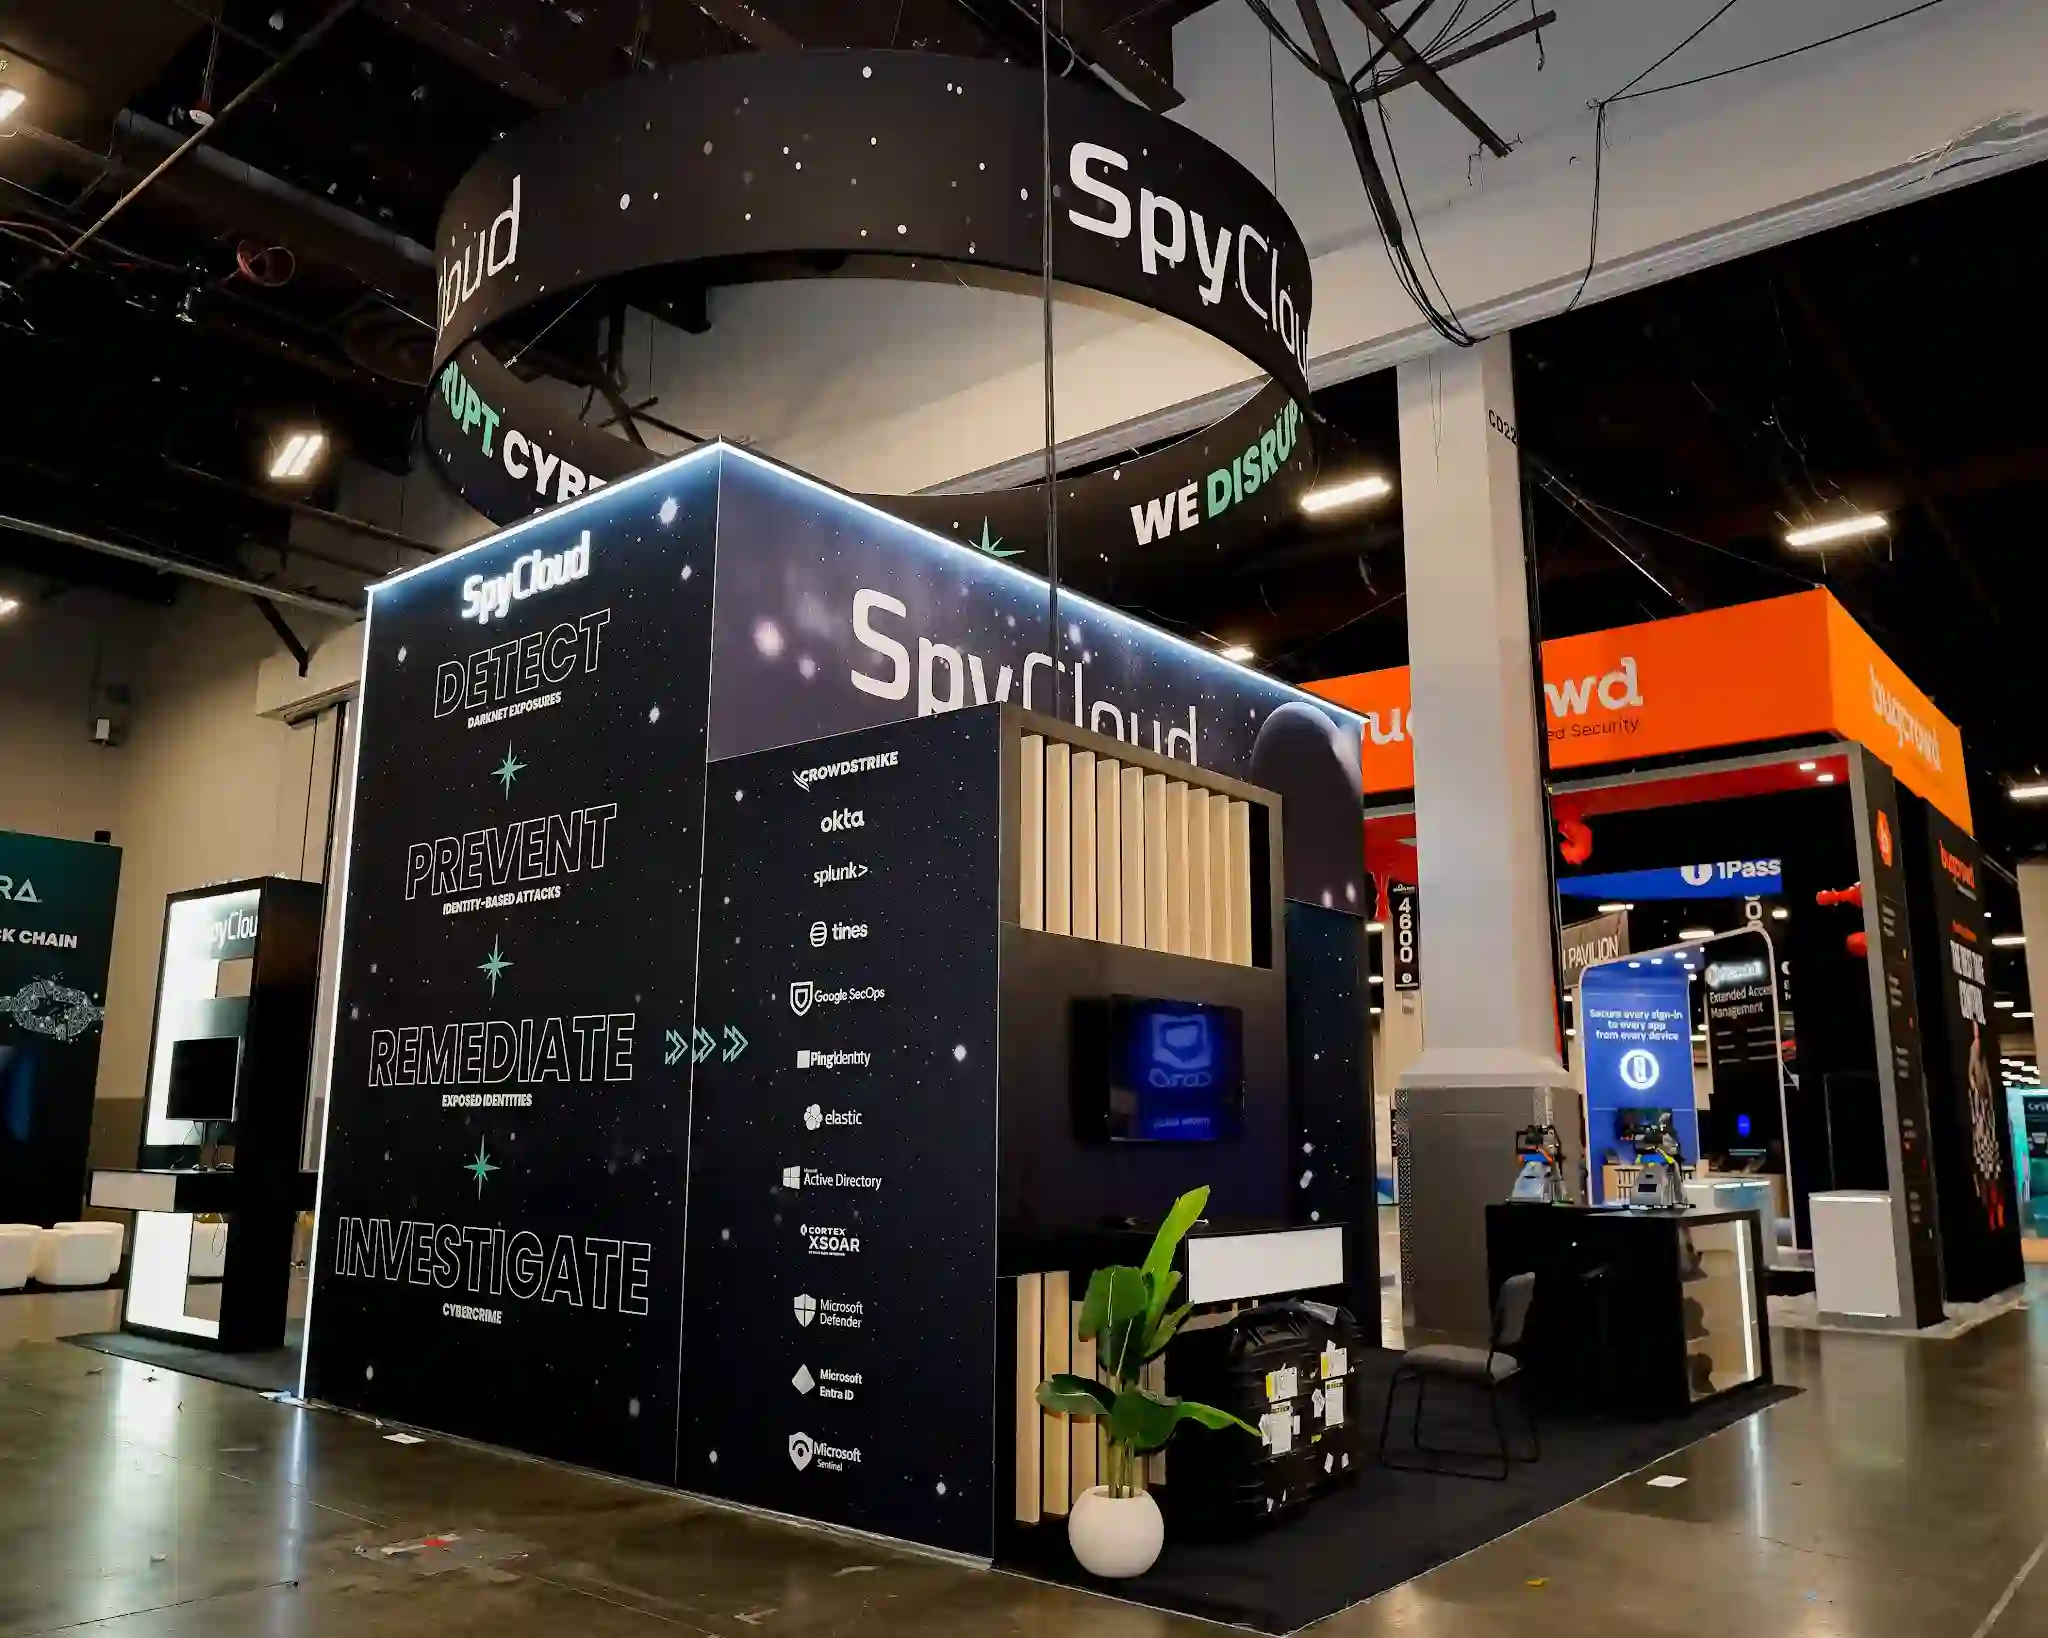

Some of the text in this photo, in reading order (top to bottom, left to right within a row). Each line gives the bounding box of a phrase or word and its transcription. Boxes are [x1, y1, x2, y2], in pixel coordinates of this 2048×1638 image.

[434, 174, 521, 365] loud
[1069, 142, 1309, 392] SpyClou
[503, 430, 608, 503] CYB
[1130, 481, 1199, 546] WE
[462, 530, 590, 624] SpyCloud
[434, 608, 611, 719] DETECT
[468, 691, 562, 729] DARKNET EXPOSURES
[1571, 717, 1641, 738] Security
[799, 751, 899, 782] CROWDSTRIKE
[820, 808, 865, 833] okta
[405, 802, 618, 900] PREVENT
[443, 885, 562, 916] IDENTITY-BASED ATTACKS
[19, 929, 78, 949] CHAIN
[832, 921, 868, 940] tines
[1398, 896, 1413, 964] 4600
[1568, 933, 1619, 969] PAVILION
[814, 986, 885, 1005] Google SecOps
[1589, 1007, 1684, 1021] Secure every sign-in
[1710, 1001, 1764, 1020] Management
[1595, 1029, 1679, 1042] from every device
[1607, 1020, 1667, 1032] to every app
[368, 1012, 636, 1087] REMEDIATE
[441, 1092, 533, 1108] EXPOSED IDENTITIES
[824, 1108, 863, 1125] elastic
[803, 1172, 882, 1191] Active Directory
[808, 1226, 847, 1236] CORTEX
[808, 1235, 860, 1253] XSOAR
[335, 1216, 651, 1316] INVESTIGATE
[442, 1302, 503, 1325] CYBERCRIME
[820, 1298, 864, 1315] Microsoft
[819, 1312, 863, 1328] Defender
[820, 1368, 863, 1385] Microsoft
[819, 1385, 855, 1401] Entra ID
[813, 1440, 862, 1463] Microsoft
[816, 1458, 844, 1472] Sentinel
